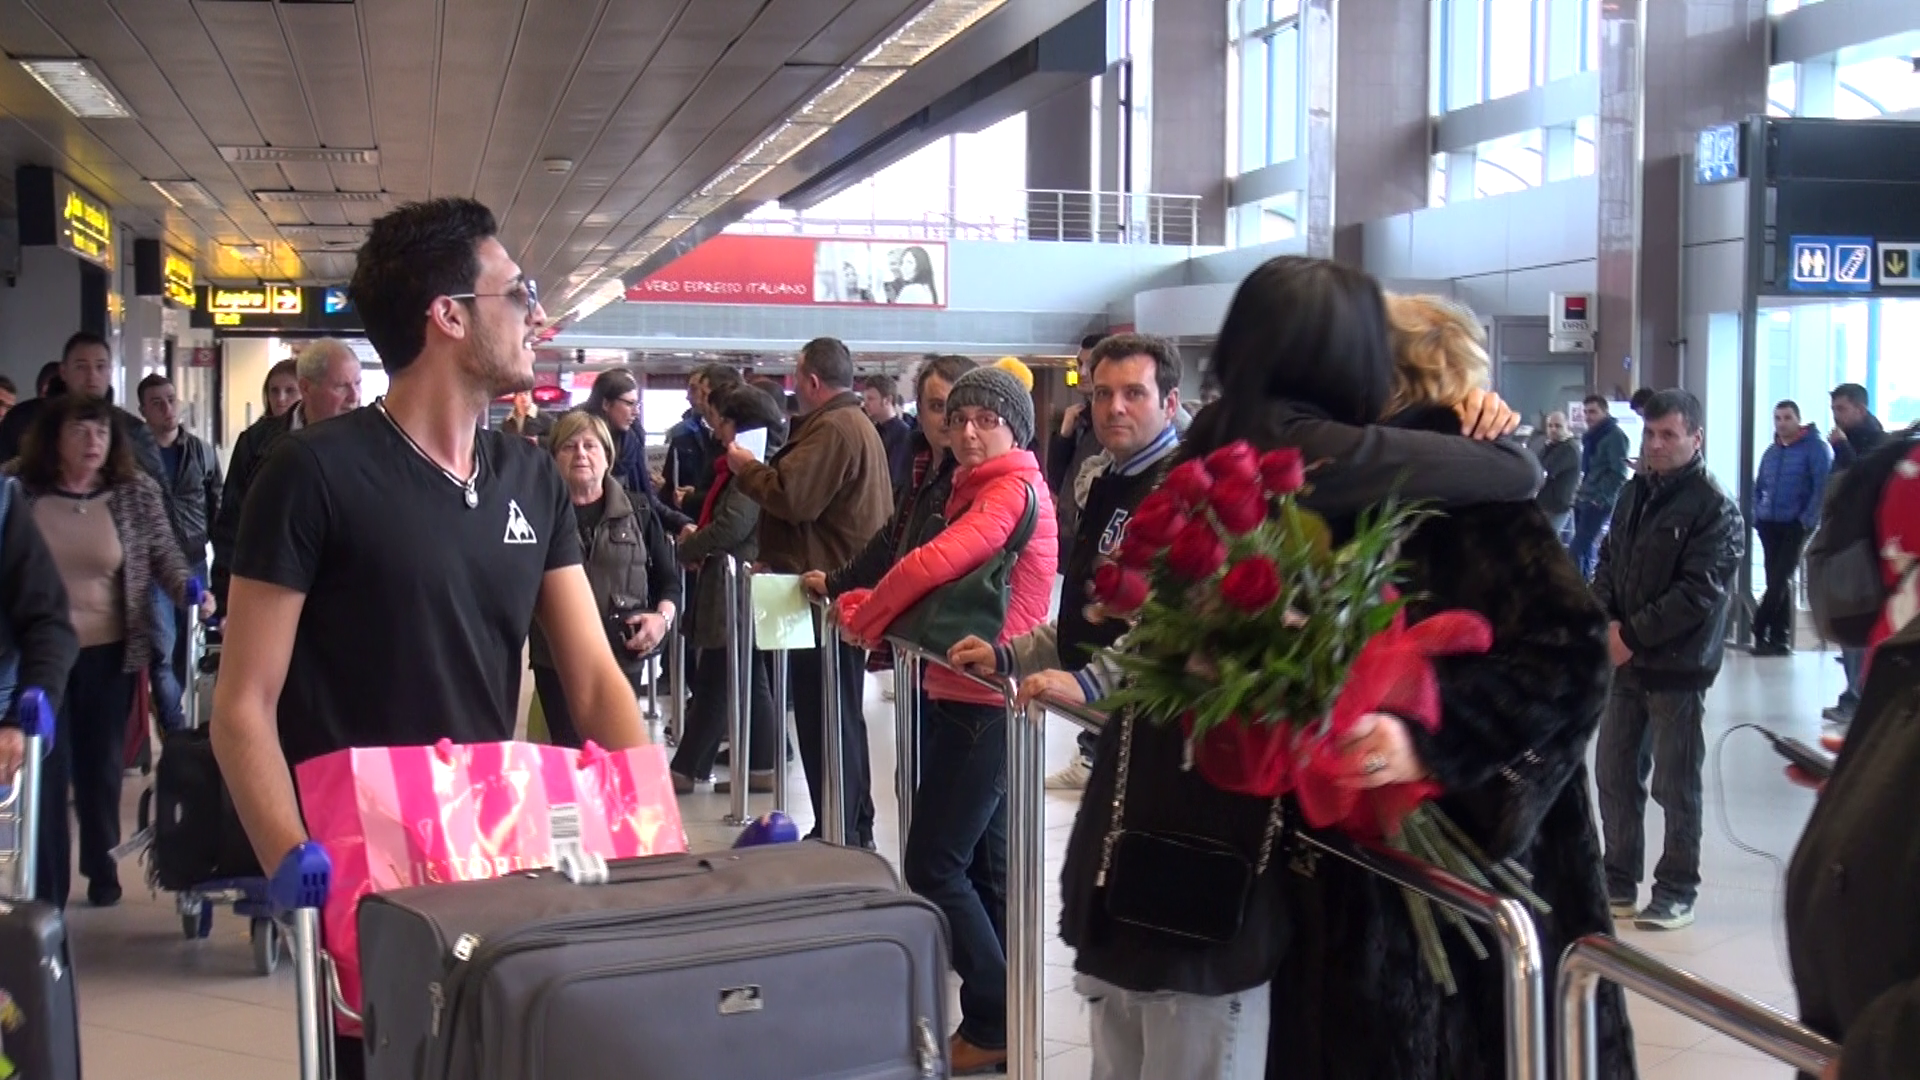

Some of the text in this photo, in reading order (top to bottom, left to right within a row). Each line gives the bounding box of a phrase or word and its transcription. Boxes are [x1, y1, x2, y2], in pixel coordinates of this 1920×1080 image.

[645, 280, 680, 292] VERO
[683, 280, 742, 294] ESPRESSO
[745, 282, 808, 295] ITALIANO
